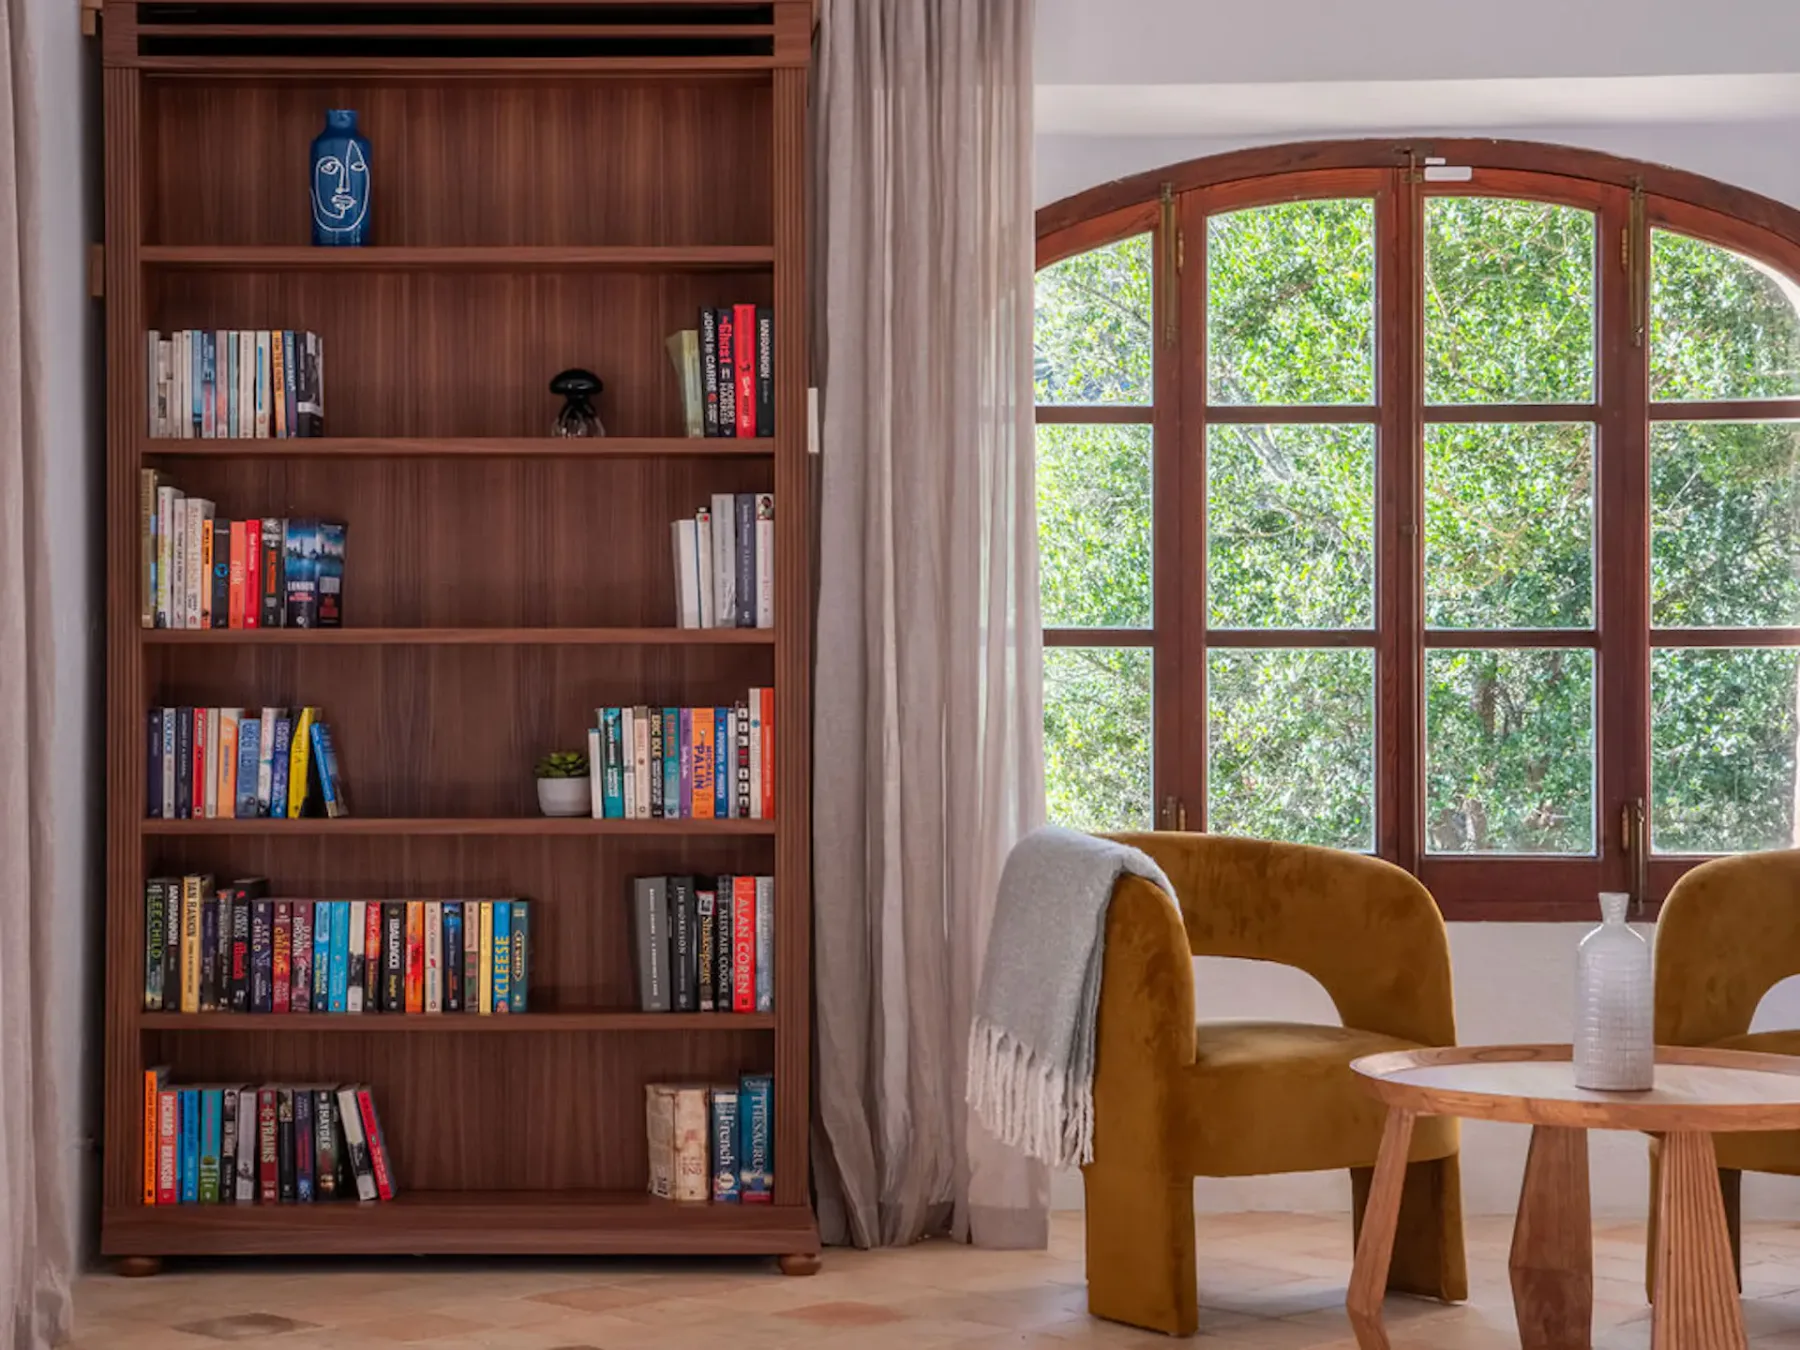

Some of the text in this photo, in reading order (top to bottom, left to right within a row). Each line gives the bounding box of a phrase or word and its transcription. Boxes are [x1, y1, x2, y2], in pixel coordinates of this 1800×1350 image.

[704, 312, 714, 342] JOHN
[694, 745, 704, 789] PALIN
[151, 897, 162, 915] LEE
[186, 881, 197, 937] IAN RANKIN
[150, 920, 162, 959] CHILD
[253, 918, 261, 952] CHILD
[261, 924, 270, 944] LEE
[274, 927, 284, 963] CHILD
[293, 917, 304, 956] BROWN
[303, 926, 311, 948] DAN
[677, 906, 686, 954] MORRISON
[699, 916, 713, 984] Shakespeare
[737, 898, 750, 994] ALAN COREN
[494, 936, 509, 995] CLEESE
[261, 1120, 275, 1163] TRAINS
[719, 1115, 735, 1166] French
[751, 1096, 765, 1176] THESAURUS
[161, 1146, 173, 1189] BRANSON
